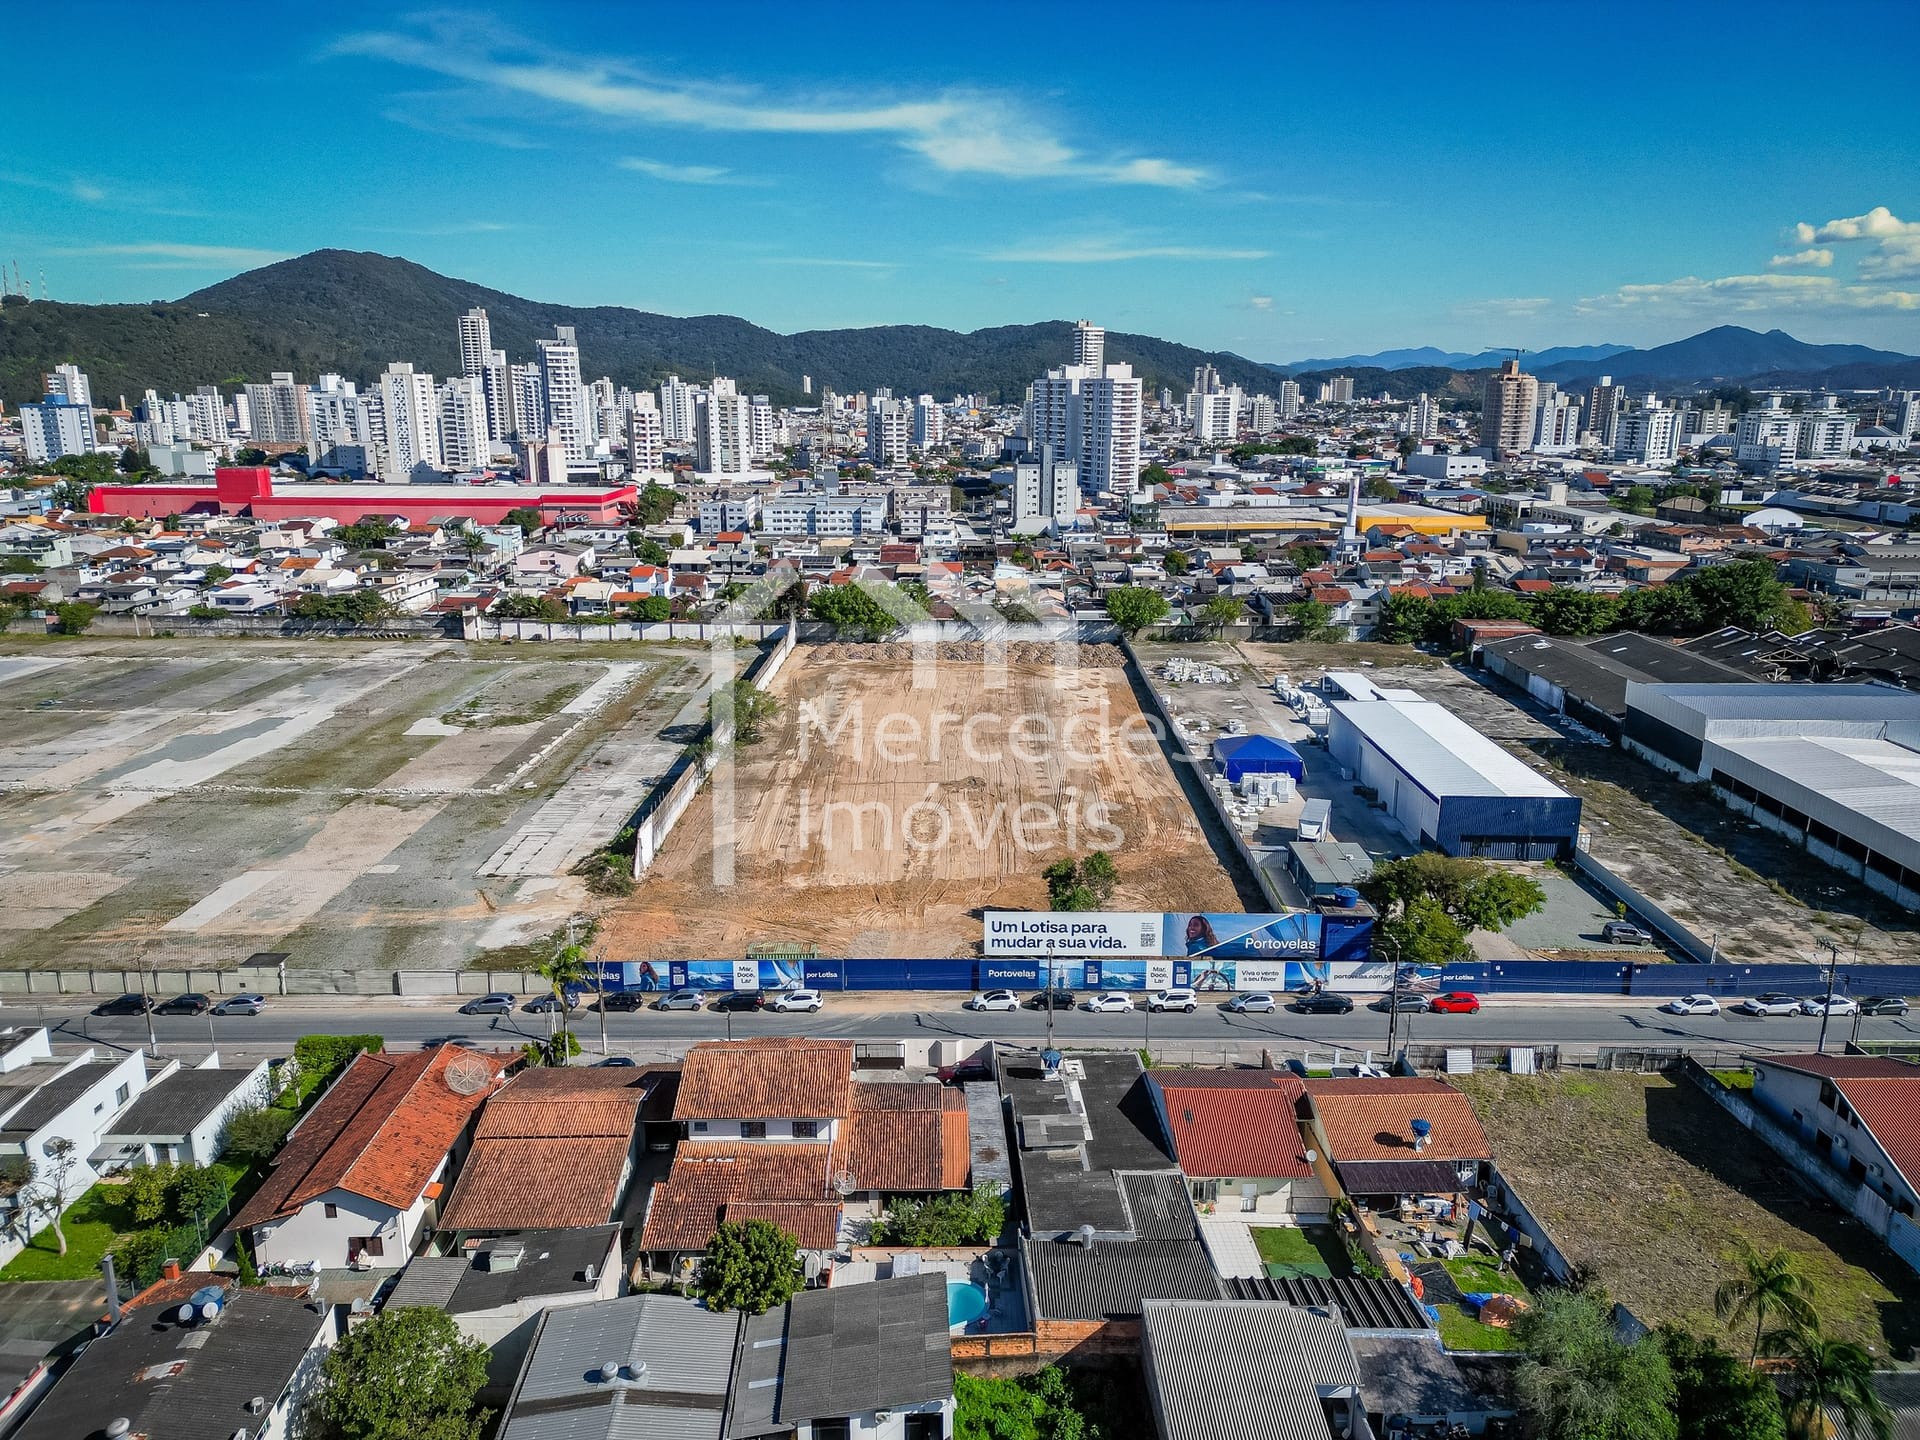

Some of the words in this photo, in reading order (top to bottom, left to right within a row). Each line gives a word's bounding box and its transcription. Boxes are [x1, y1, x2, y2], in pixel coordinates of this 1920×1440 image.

[1855, 439, 1907, 449] AVAN
[991, 920, 1018, 933] Um
[1021, 920, 1068, 934] Lotisa
[1071, 923, 1107, 936] para
[991, 936, 1043, 948] mudar
[1045, 938, 1056, 949] a
[1058, 938, 1087, 949] sua
[1089, 936, 1127, 949] vida.
[1245, 938, 1316, 950] Portovelas
[988, 969, 1036, 978] Portovelas
